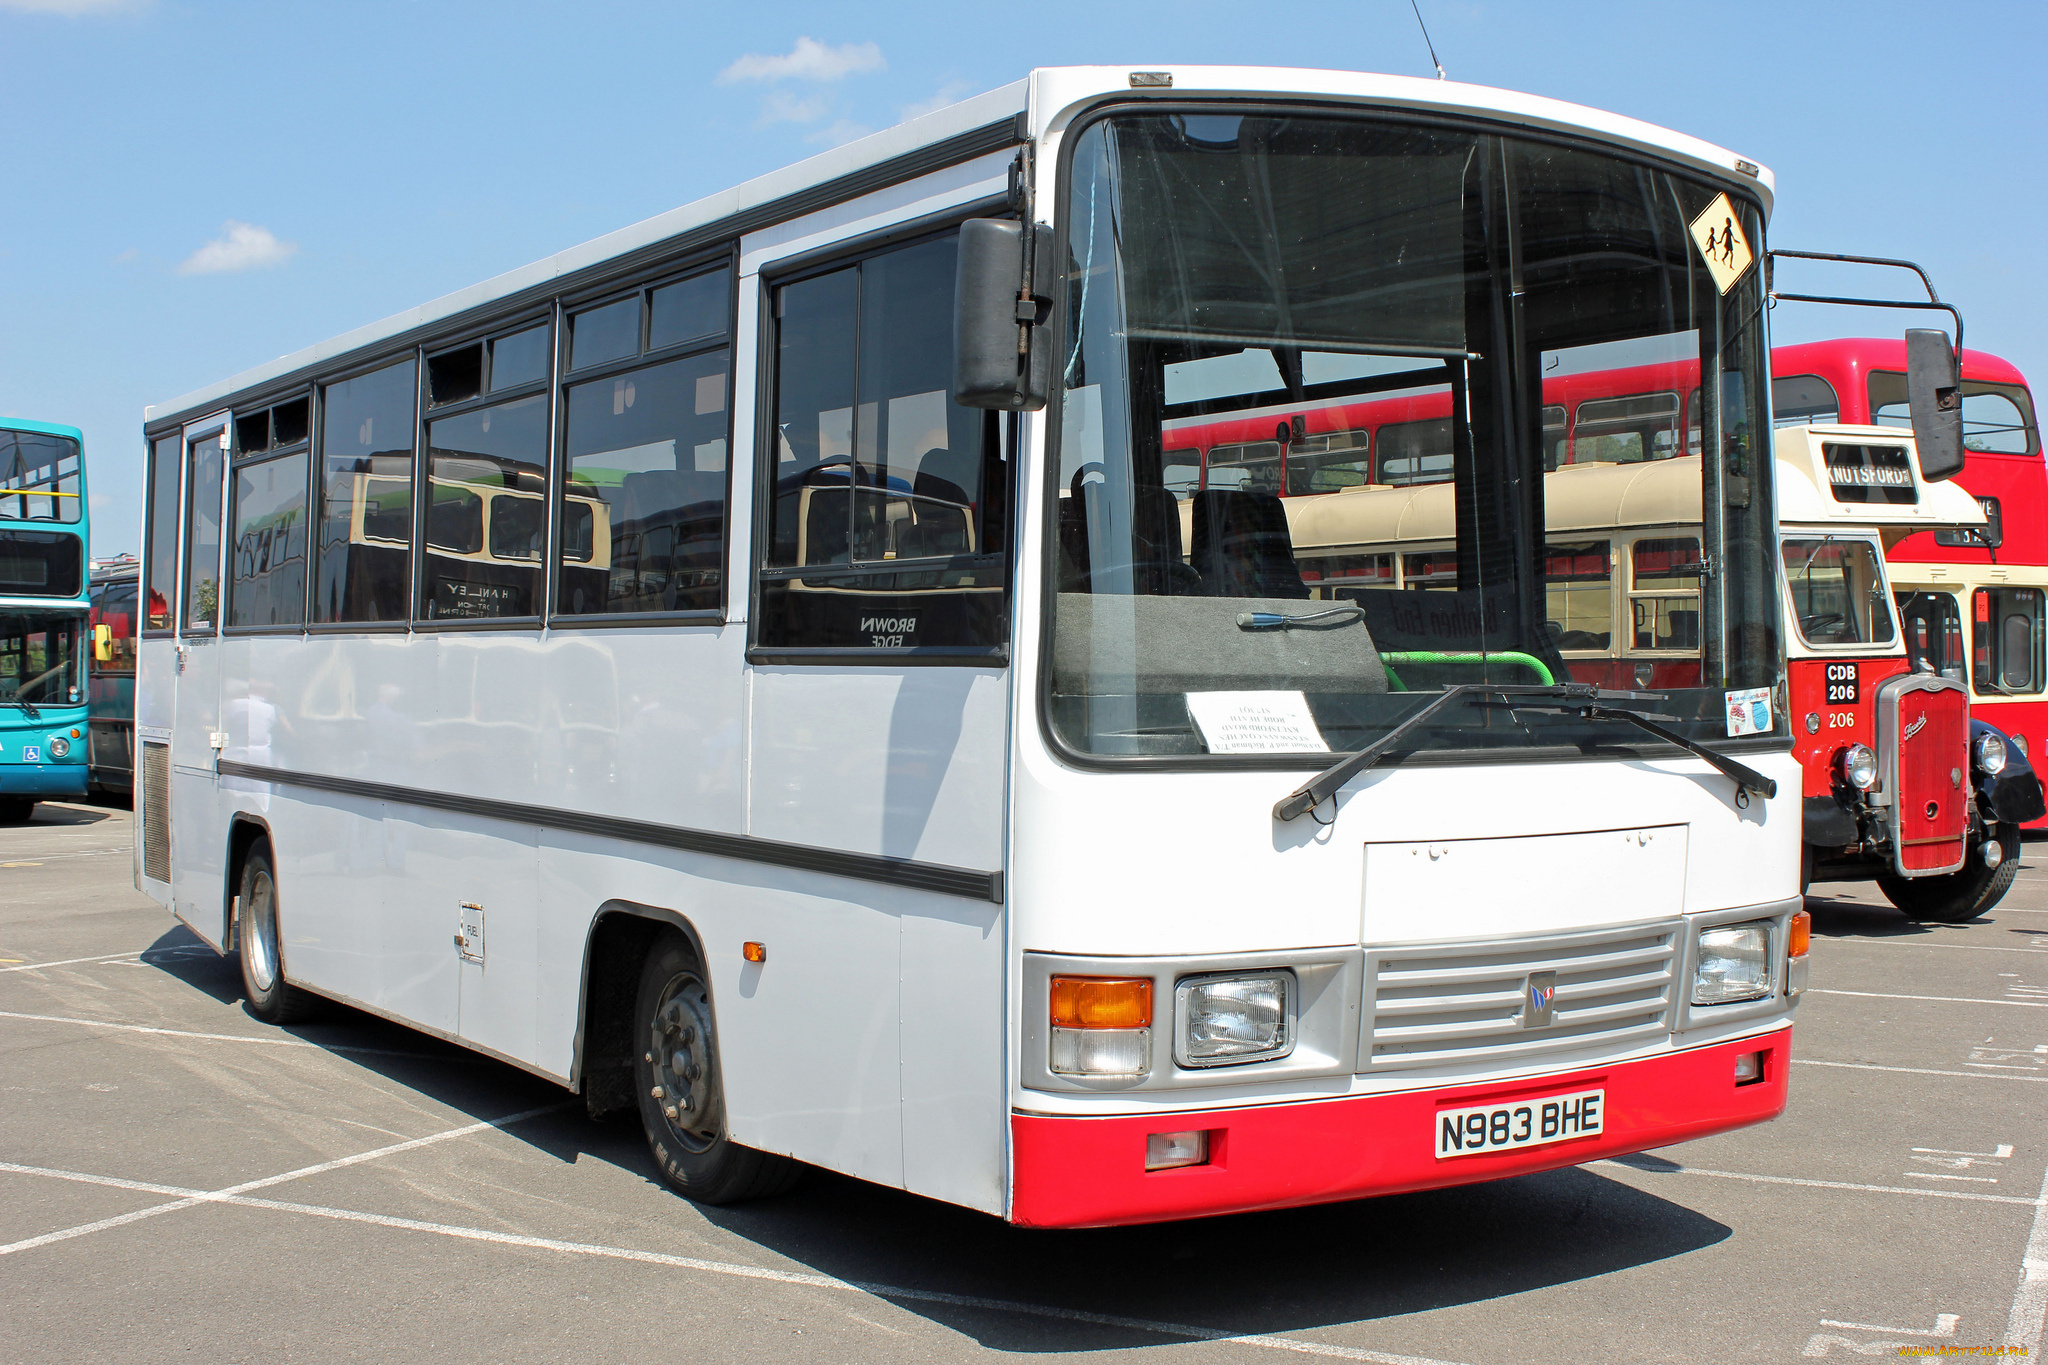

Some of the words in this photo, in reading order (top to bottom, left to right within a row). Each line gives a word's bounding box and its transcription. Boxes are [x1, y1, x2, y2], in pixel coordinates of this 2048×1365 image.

[1827, 465, 1903, 484] KNUTSFORD
[1827, 665, 1856, 680] CDB
[1828, 685, 1855, 700] 206
[1829, 712, 1855, 728] 206
[1249, 724, 1299, 733] KNUTSFORD
[1442, 1106, 1532, 1152] N983
[1541, 1095, 1600, 1139] BHE
